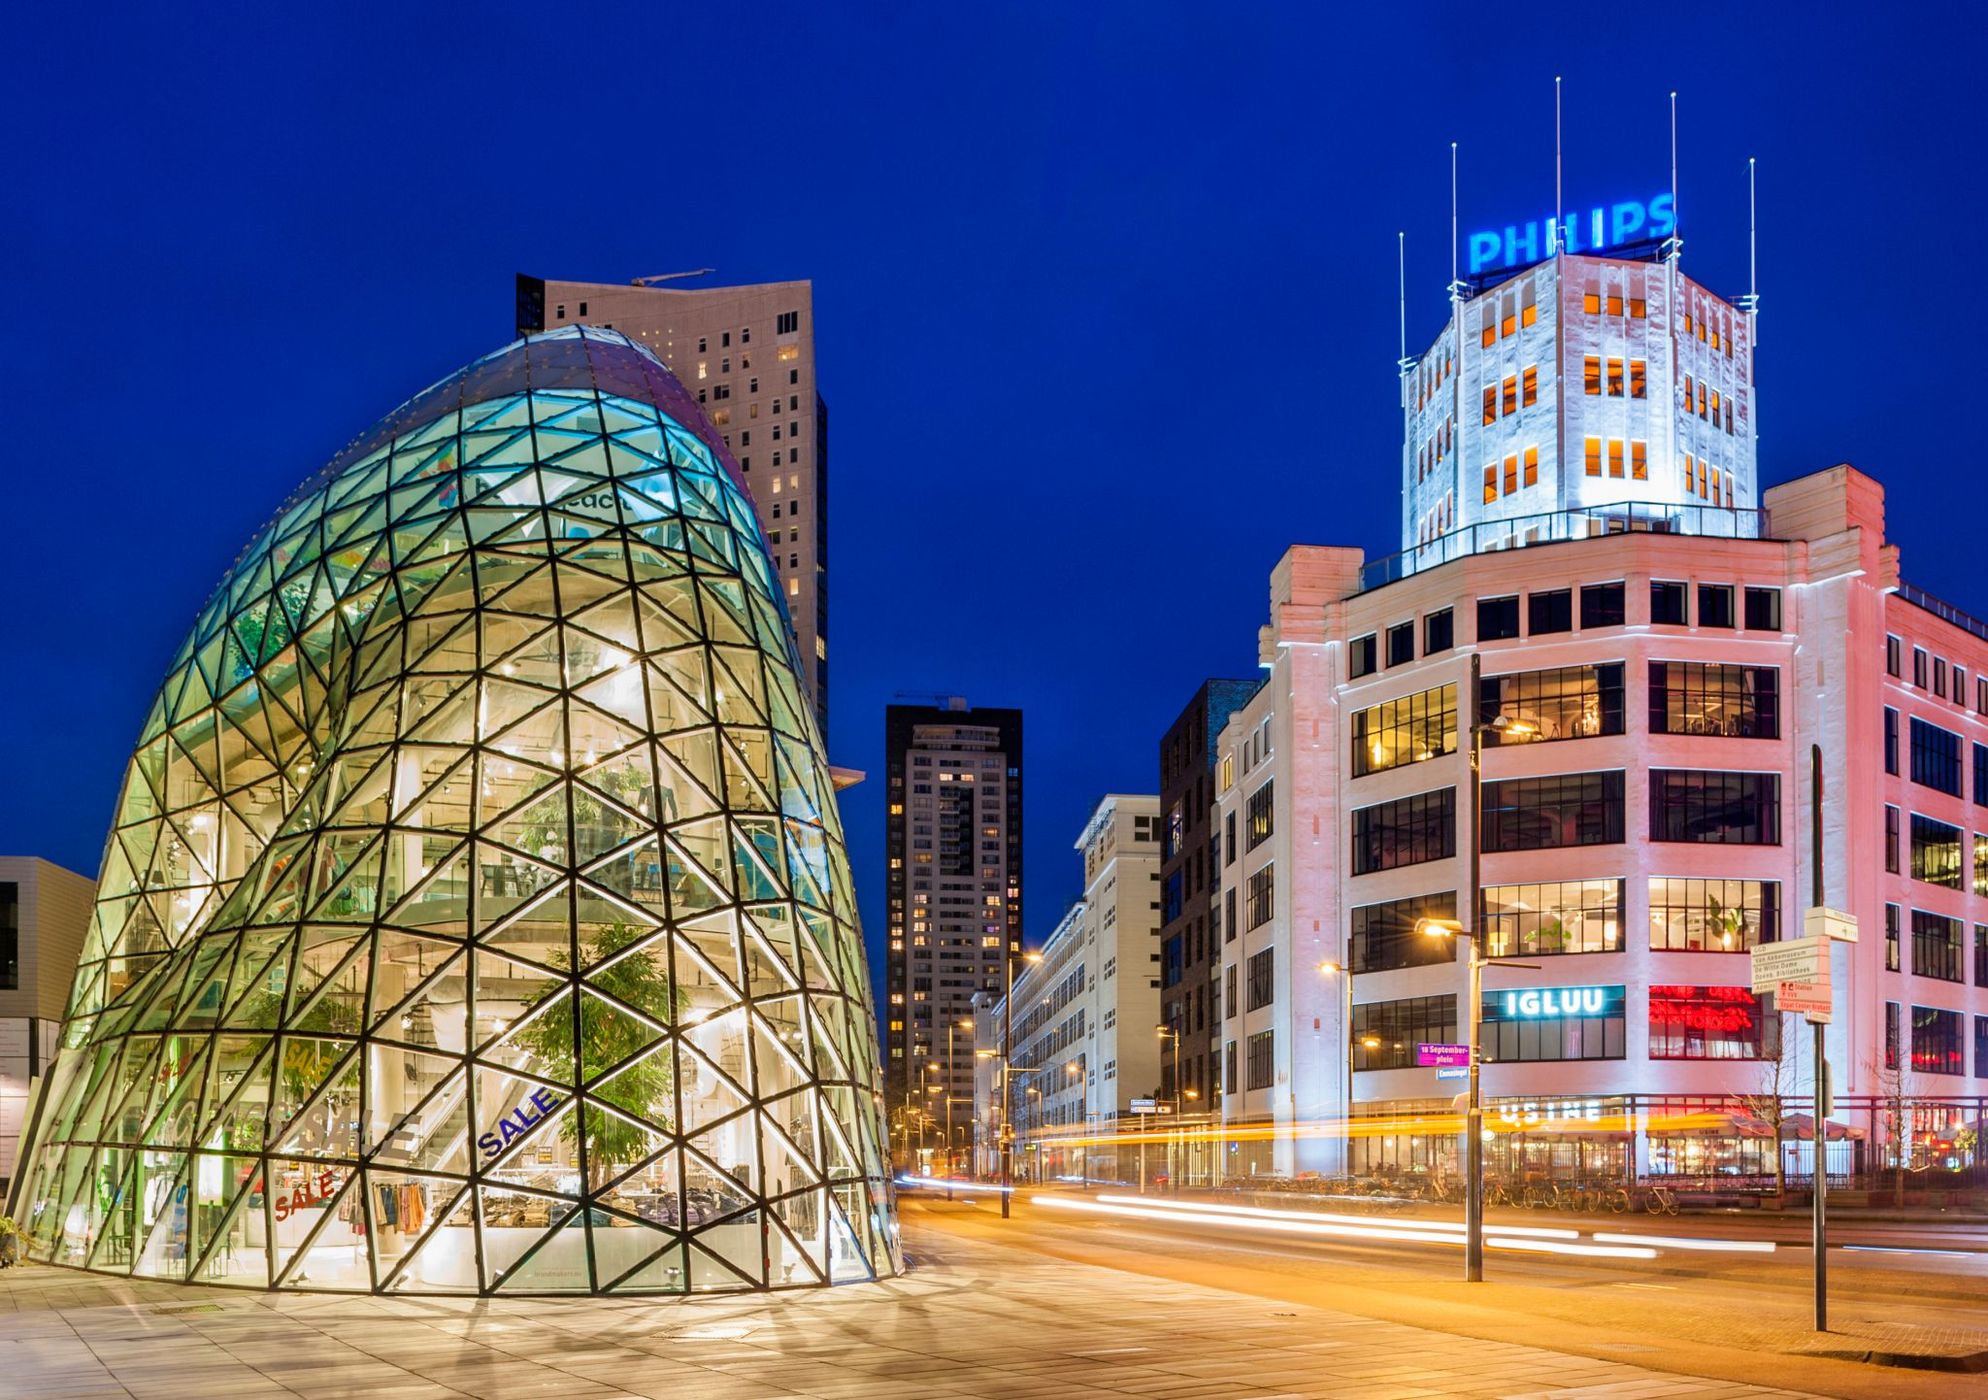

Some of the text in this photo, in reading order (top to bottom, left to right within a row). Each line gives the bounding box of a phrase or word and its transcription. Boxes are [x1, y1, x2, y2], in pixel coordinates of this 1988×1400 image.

[1469, 193, 1677, 274] PHILIPS
[1754, 961, 1797, 973] De Witte Dame
[1776, 967, 1810, 977] Bibliotheek
[1795, 983, 1813, 991] Station
[1508, 989, 1603, 1015] IGLUU
[1429, 1045, 1468, 1055] September-
[1436, 1055, 1454, 1064] plein
[1500, 1101, 1600, 1124] USINE
[477, 1086, 562, 1158] SALE
[275, 1170, 336, 1222] SALE
